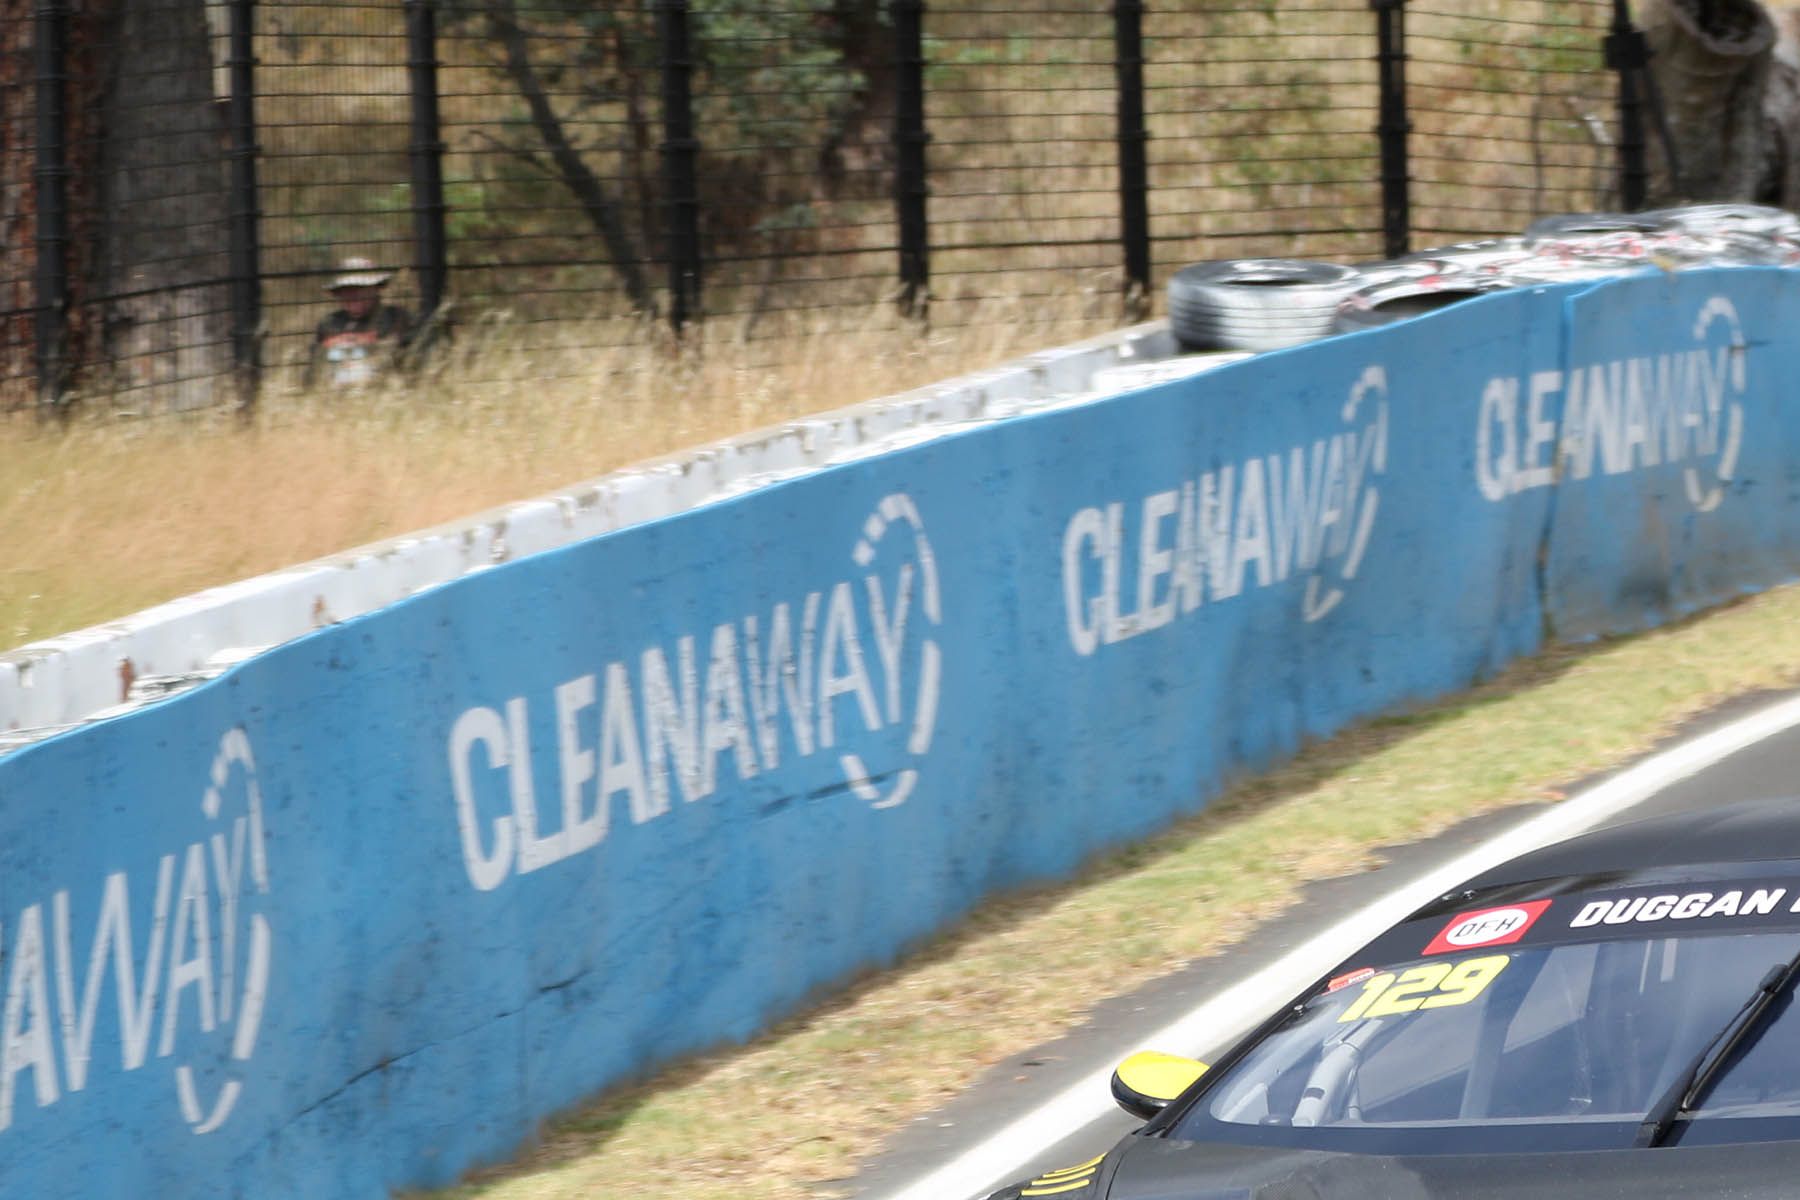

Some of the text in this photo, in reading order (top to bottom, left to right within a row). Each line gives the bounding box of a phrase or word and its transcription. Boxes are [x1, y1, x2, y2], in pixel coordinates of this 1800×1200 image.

[1476, 346, 1727, 501] CLEANAWAY
[1063, 430, 1371, 655] CLEANAWAY
[449, 562, 914, 890] CLEANAWAY
[0, 816, 247, 1130] AWAY
[1336, 954, 1511, 1023] 129
[1569, 888, 1787, 928] DUGGAN
